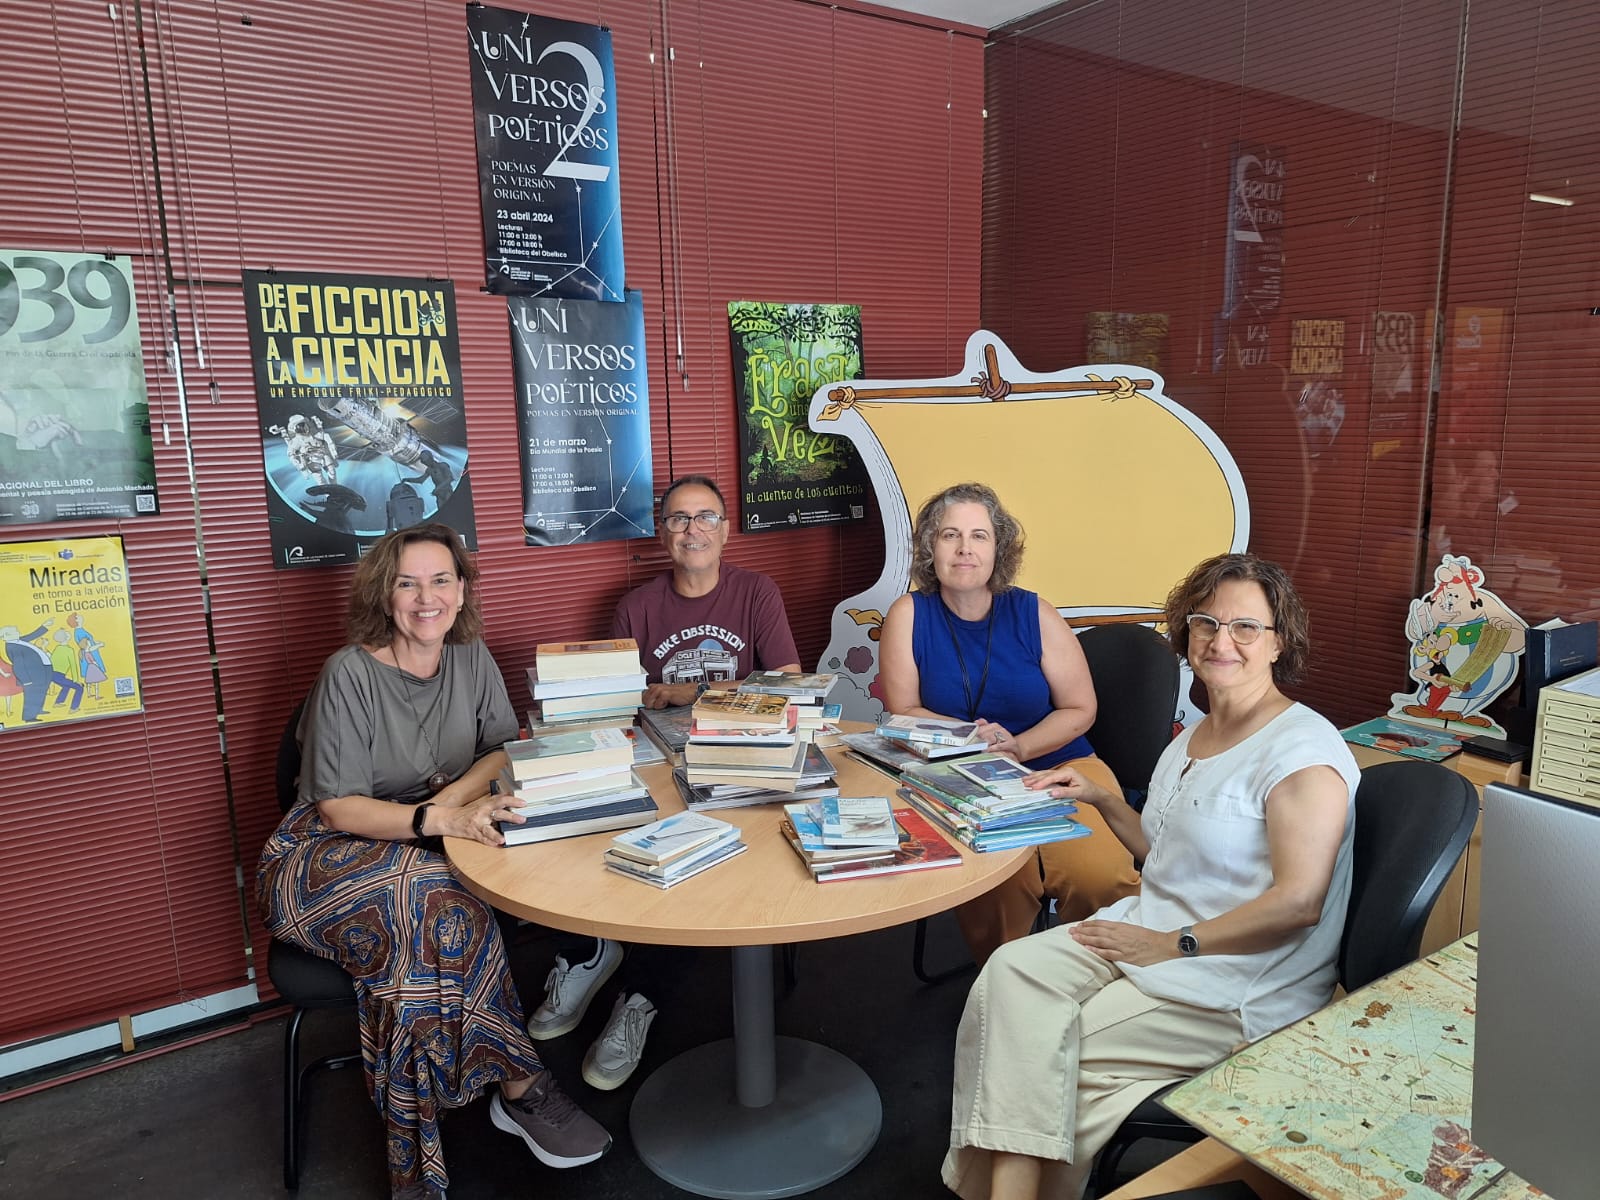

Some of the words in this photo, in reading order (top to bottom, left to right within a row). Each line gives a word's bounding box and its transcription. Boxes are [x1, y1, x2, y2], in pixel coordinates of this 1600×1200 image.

[481, 31, 533, 64] UNI
[485, 71, 607, 114] VERSOS
[536, 41, 611, 182] 2
[491, 160, 536, 174] POEMAS
[492, 174, 507, 185] EN
[510, 175, 556, 190] VERSIÓN
[493, 188, 545, 203] ORIGINAL
[497, 209, 509, 219] 23
[510, 210, 531, 221] abril
[532, 212, 553, 224] 2024
[497, 223, 523, 232] Lecturas
[258, 283, 286, 308] DE
[261, 308, 288, 333] LA
[520, 307, 568, 333] UNI
[266, 336, 281, 360] A
[523, 344, 636, 371] VERSOS
[267, 360, 293, 385] LA
[292, 336, 451, 385] CIENCIA
[270, 387, 284, 398] UN
[291, 387, 343, 397] ENFOQUE
[527, 409, 559, 418] POEMAS
[561, 409, 572, 417] EN
[606, 407, 639, 416] ORIGINAL
[529, 438, 540, 447] 21
[543, 438, 556, 447] de
[558, 438, 587, 446] marzo
[44, 480, 63, 488] DEL
[65, 478, 93, 486] LIBRO
[29, 564, 122, 588] Miradas
[33, 592, 45, 600] en
[48, 590, 73, 599] torno
[84, 587, 93, 595] la
[33, 603, 50, 614] en
[55, 595, 125, 613] Educación
[653, 634, 681, 659] BIKE
[681, 624, 746, 652] OBSESSION
